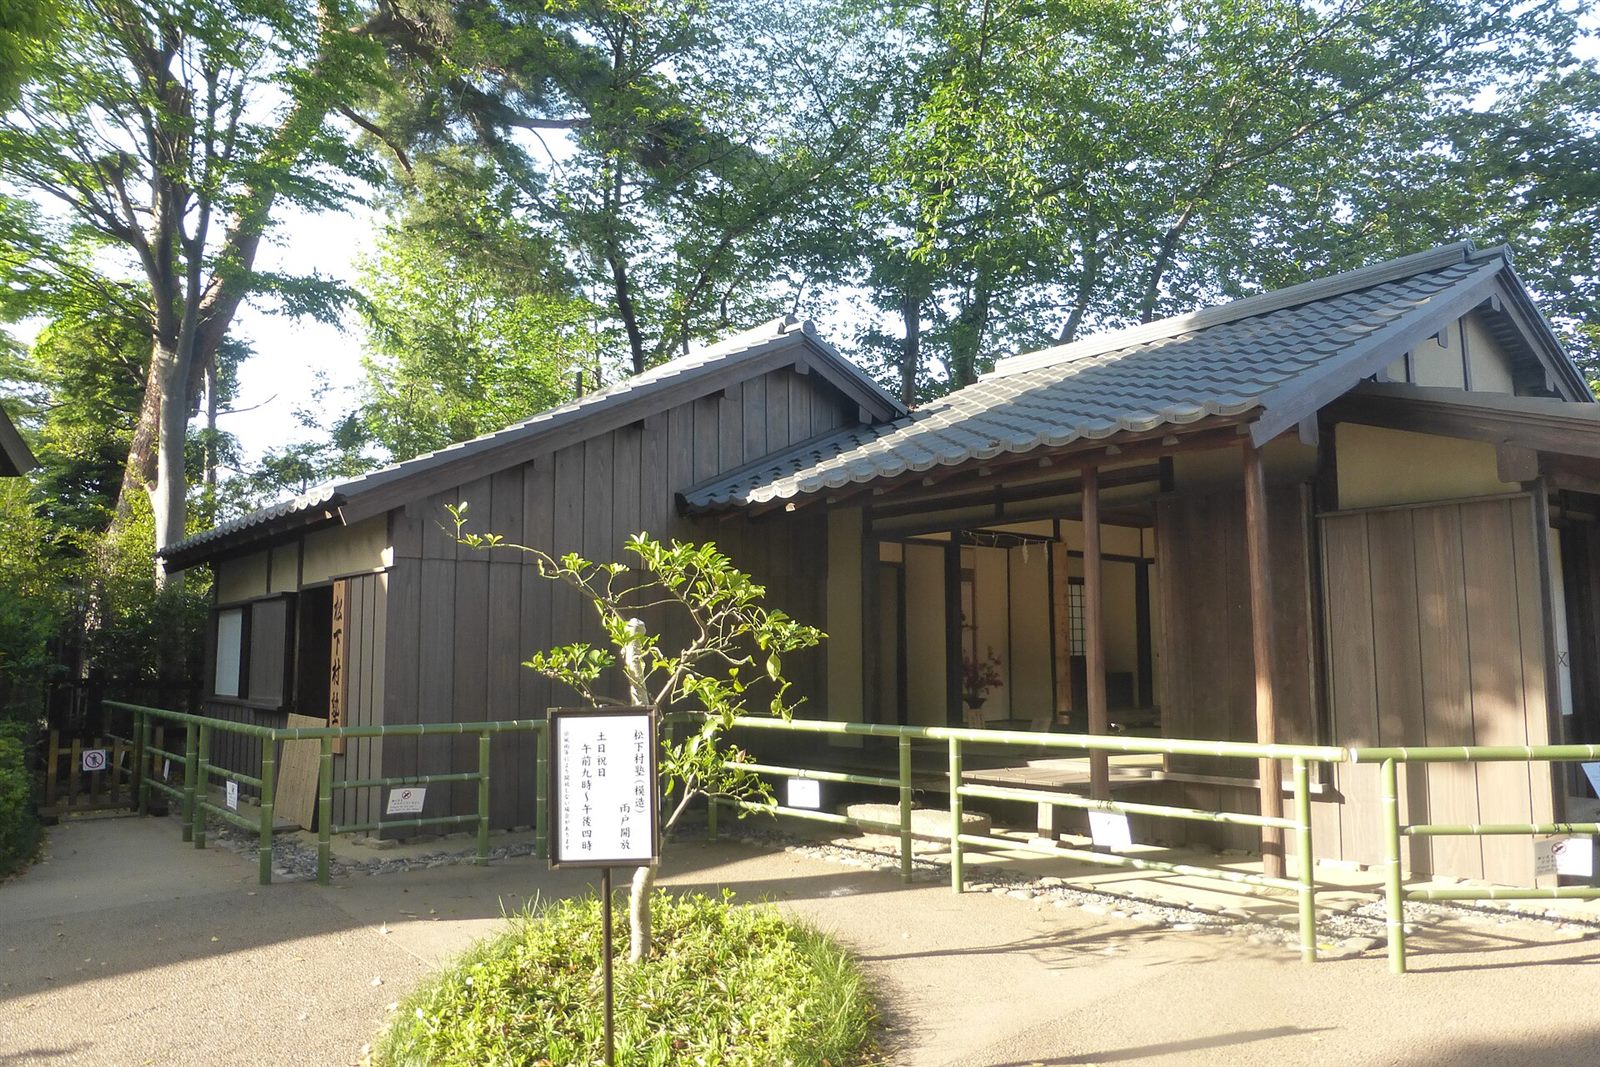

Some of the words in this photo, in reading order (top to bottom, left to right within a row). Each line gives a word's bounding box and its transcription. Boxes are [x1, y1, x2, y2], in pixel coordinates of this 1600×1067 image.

[331, 596, 343, 724] 松下村塾
[597, 731, 607, 777] 土日祝日
[620, 803, 631, 850] 雨戸開放
